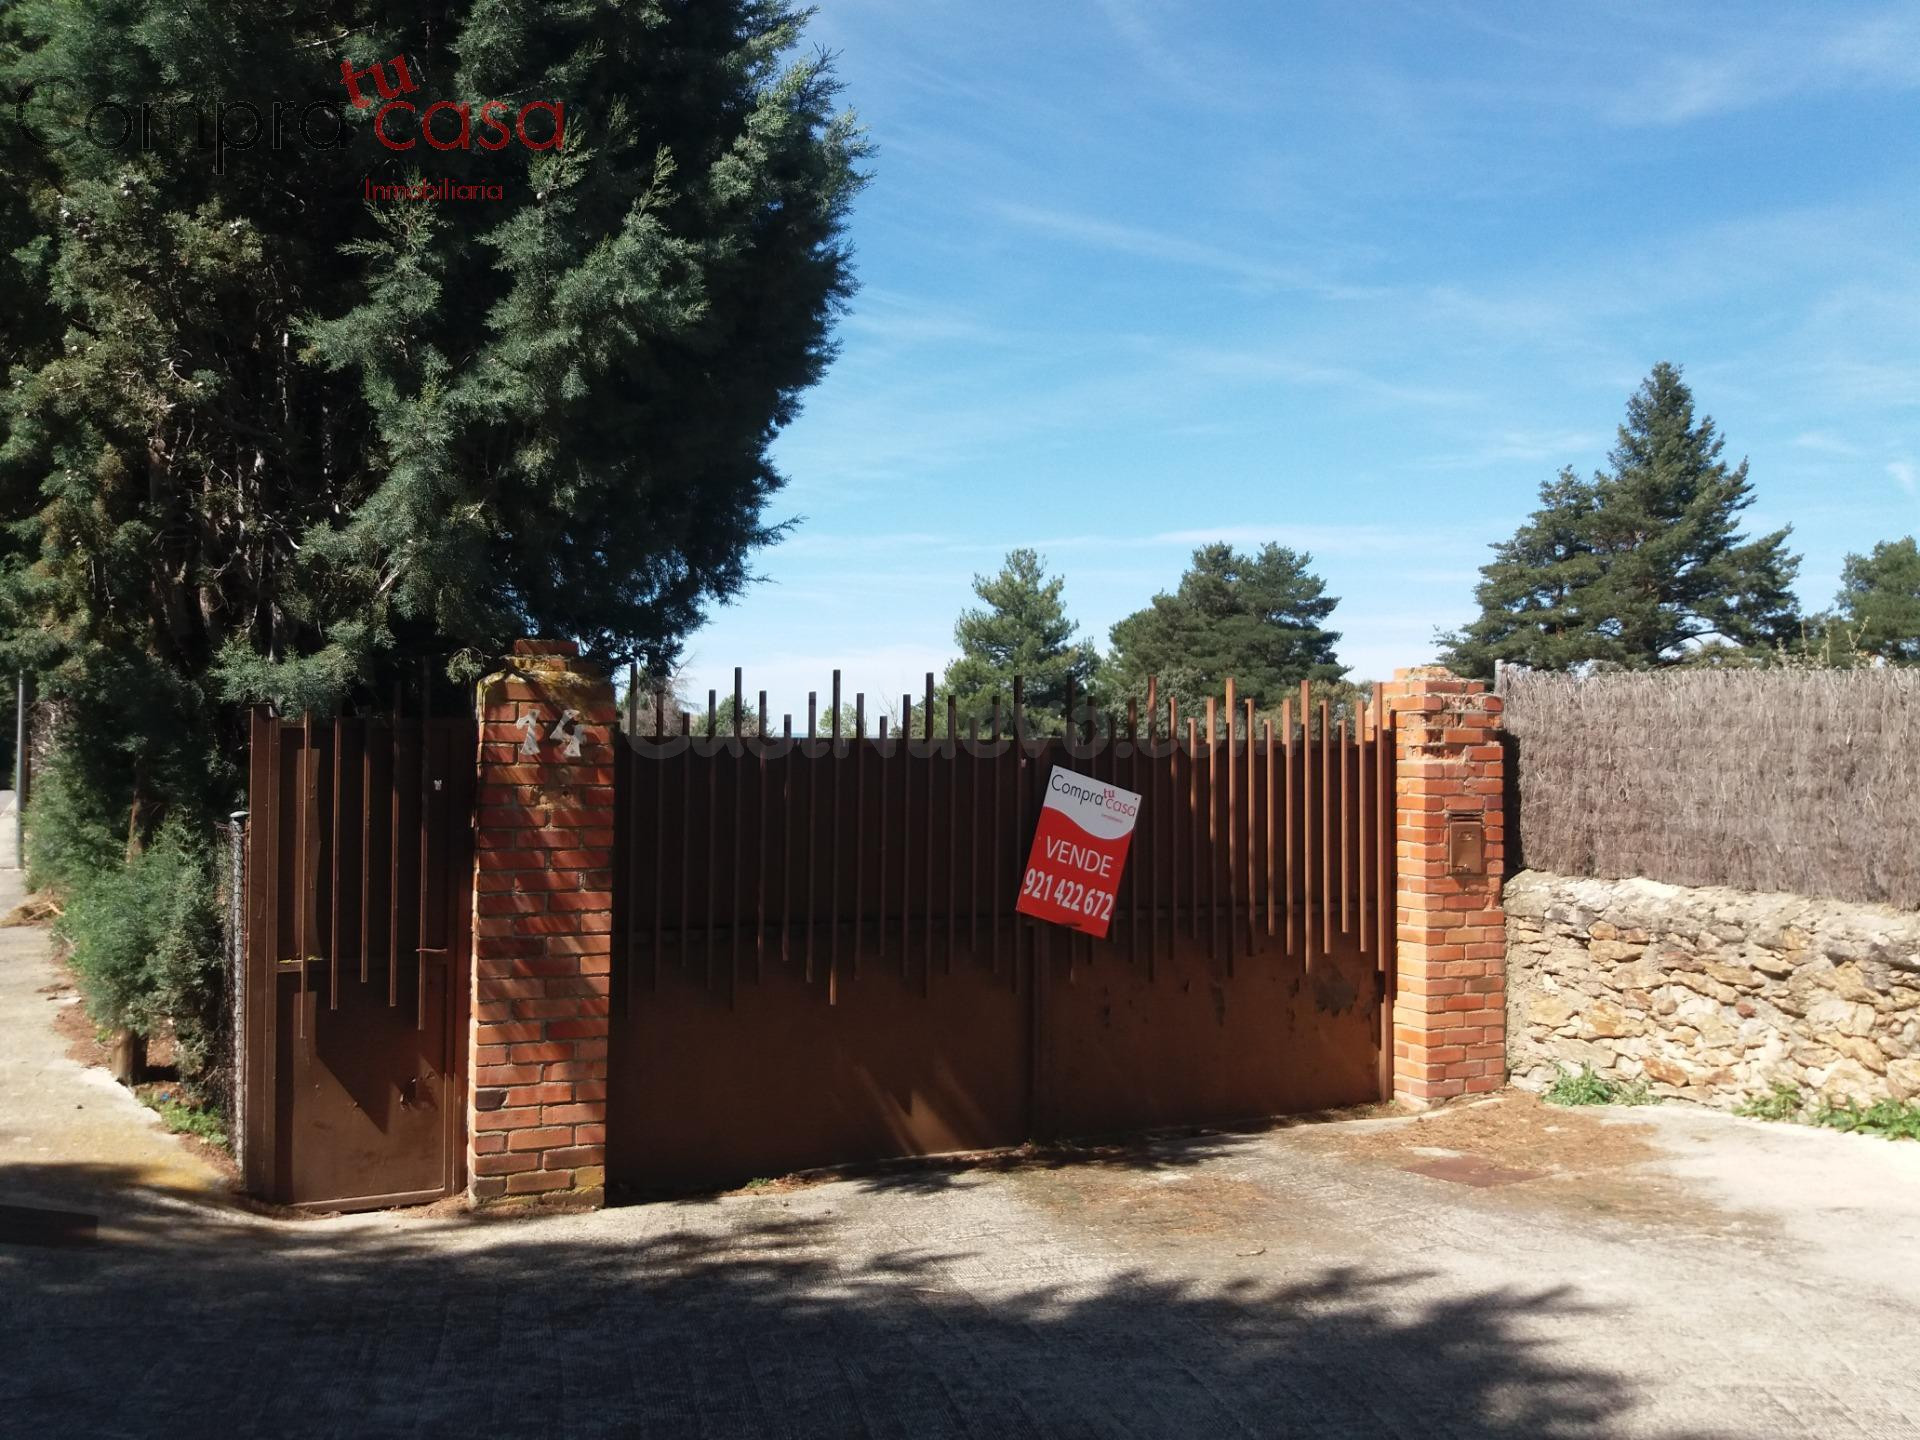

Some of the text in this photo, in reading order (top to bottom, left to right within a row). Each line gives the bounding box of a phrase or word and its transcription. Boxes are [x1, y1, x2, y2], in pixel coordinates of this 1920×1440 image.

[516, 709, 587, 757] 14
[1051, 774, 1136, 817] Compra tu casa
[1046, 835, 1113, 878] VENDE
[1023, 868, 1114, 921] 921 422 672
